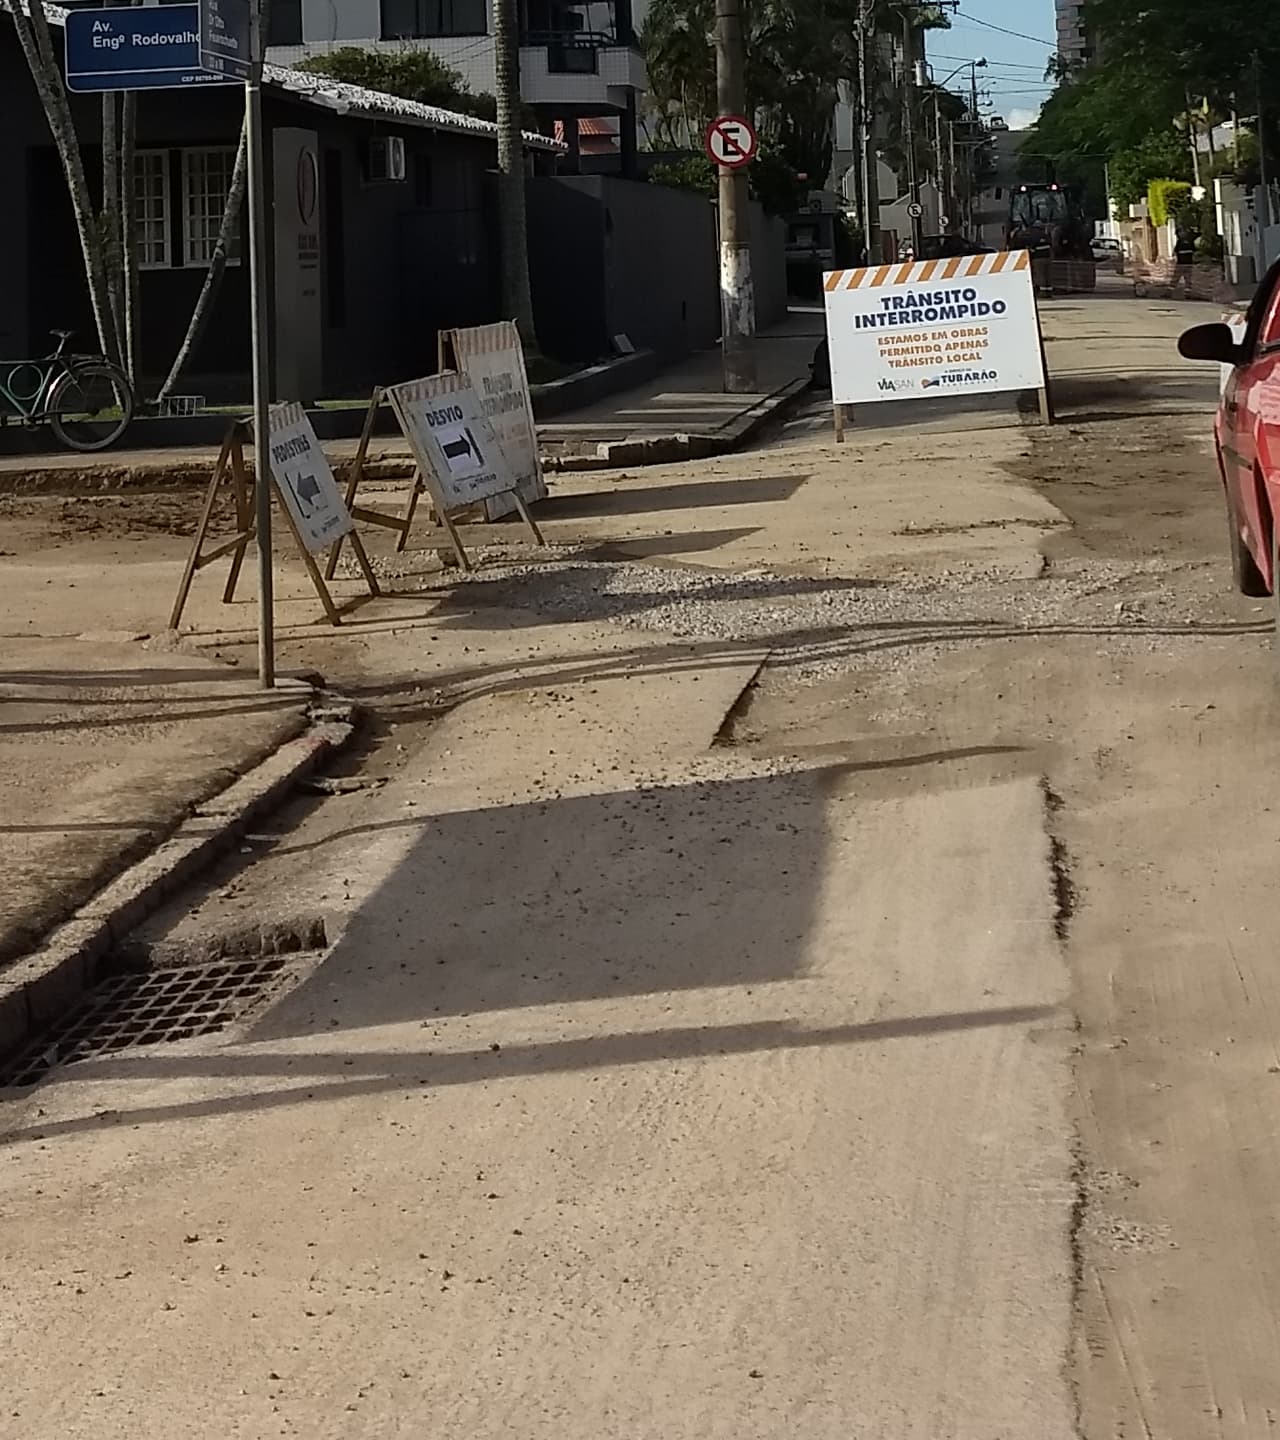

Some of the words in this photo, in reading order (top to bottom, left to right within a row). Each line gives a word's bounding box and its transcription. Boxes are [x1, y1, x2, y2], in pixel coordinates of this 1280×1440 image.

[92, 20, 113, 33] Av.
[722, 127, 740, 157] E
[880, 287, 977, 311] TRÂNSITO
[854, 300, 1007, 329] INTERROMPIDO
[877, 333, 928, 346] ESTAMOS
[931, 330, 948, 341] EM
[951, 327, 989, 338] OBRAS
[945, 338, 989, 351] APENAS
[946, 352, 982, 364] LOCAL
[425, 405, 464, 428] DESVIO
